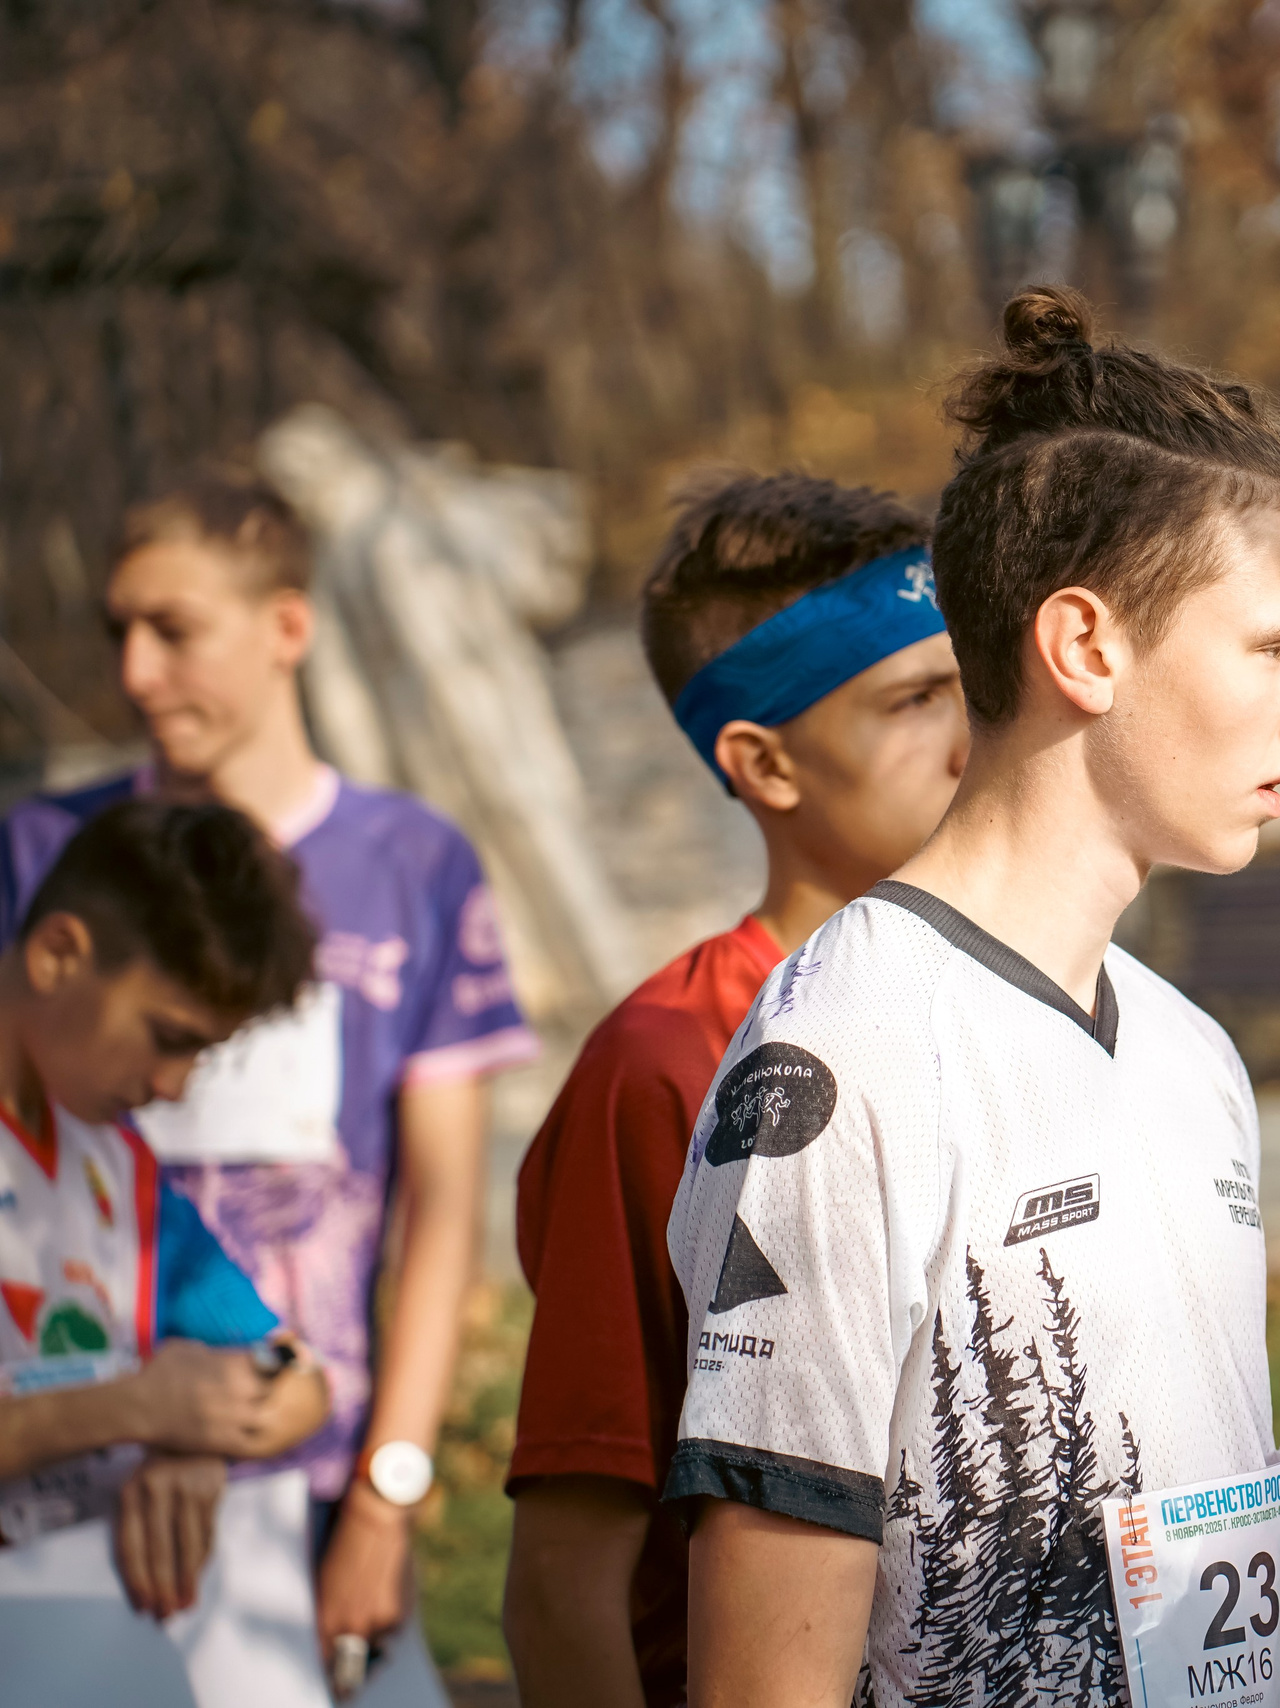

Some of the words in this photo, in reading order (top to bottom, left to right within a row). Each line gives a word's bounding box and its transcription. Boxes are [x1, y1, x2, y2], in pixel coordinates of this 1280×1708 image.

[1017, 1216, 1058, 1237] MASS
[1061, 1207, 1094, 1223] SPORT
[1160, 1480, 1263, 1526] ПЕРВЕНСТВО
[1118, 1503, 1158, 1587] ЭТАП
[1165, 1529, 1172, 1542] 8
[1172, 1523, 1204, 1540] НОЯБРЯ
[1204, 1519, 1223, 1535] 2025
[1129, 1592, 1163, 1610] 1
[1187, 1647, 1273, 1698] МЖ16
[1239, 1692, 1264, 1706] Федор
